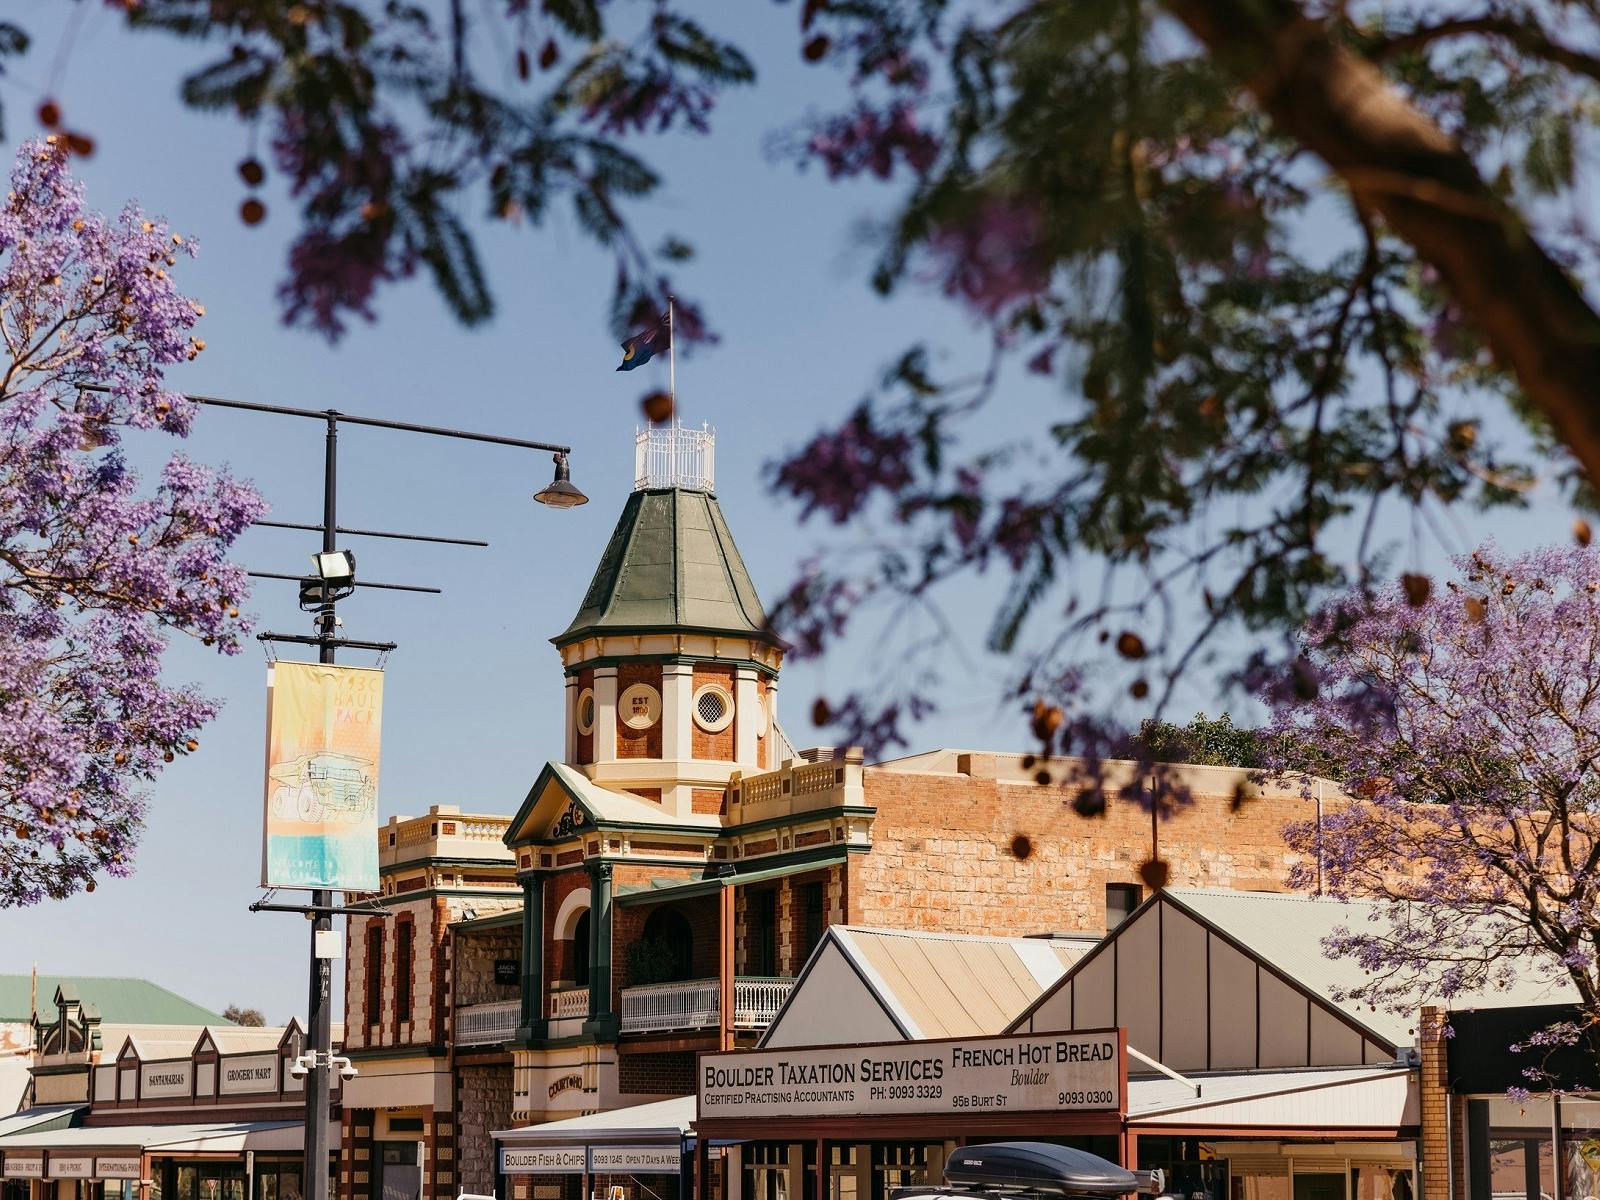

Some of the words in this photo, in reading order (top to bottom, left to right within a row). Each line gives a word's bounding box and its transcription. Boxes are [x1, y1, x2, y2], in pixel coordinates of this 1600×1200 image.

[632, 697, 649, 705] EST
[336, 709, 376, 725] PACK
[952, 1047, 1014, 1068] FRENCH
[1018, 1044, 1051, 1064] HOT
[1056, 1041, 1113, 1063] BREAD
[255, 1067, 272, 1080] MART
[705, 1066, 774, 1088] BOULDER
[778, 1062, 856, 1085] TAXATION
[860, 1058, 943, 1082] SERVICES
[1011, 1068, 1050, 1086] Boulder
[548, 1076, 570, 1098] COURT
[870, 1087, 887, 1100] PH:
[889, 1085, 914, 1099] 9093
[916, 1085, 942, 1099] 3329
[704, 1092, 743, 1105] CERTIFIED
[745, 1091, 791, 1104] PRACTISING
[794, 1089, 855, 1103] ACCOUNTANTS
[971, 1095, 994, 1107] BURT
[996, 1094, 1007, 1106] ST
[1058, 1091, 1085, 1105] 9093
[1086, 1090, 1113, 1104] 0300
[505, 1154, 537, 1166] BOULDER
[538, 1154, 554, 1166] FISH
[556, 1153, 561, 1165] &
[563, 1153, 585, 1165] CHIPS
[594, 1155, 608, 1164] 9093
[609, 1155, 622, 1164] 1245
[625, 1155, 640, 1164] OPEN
[641, 1155, 645, 1164] 7
[646, 1155, 660, 1164] DAYS
[661, 1155, 665, 1164] A
